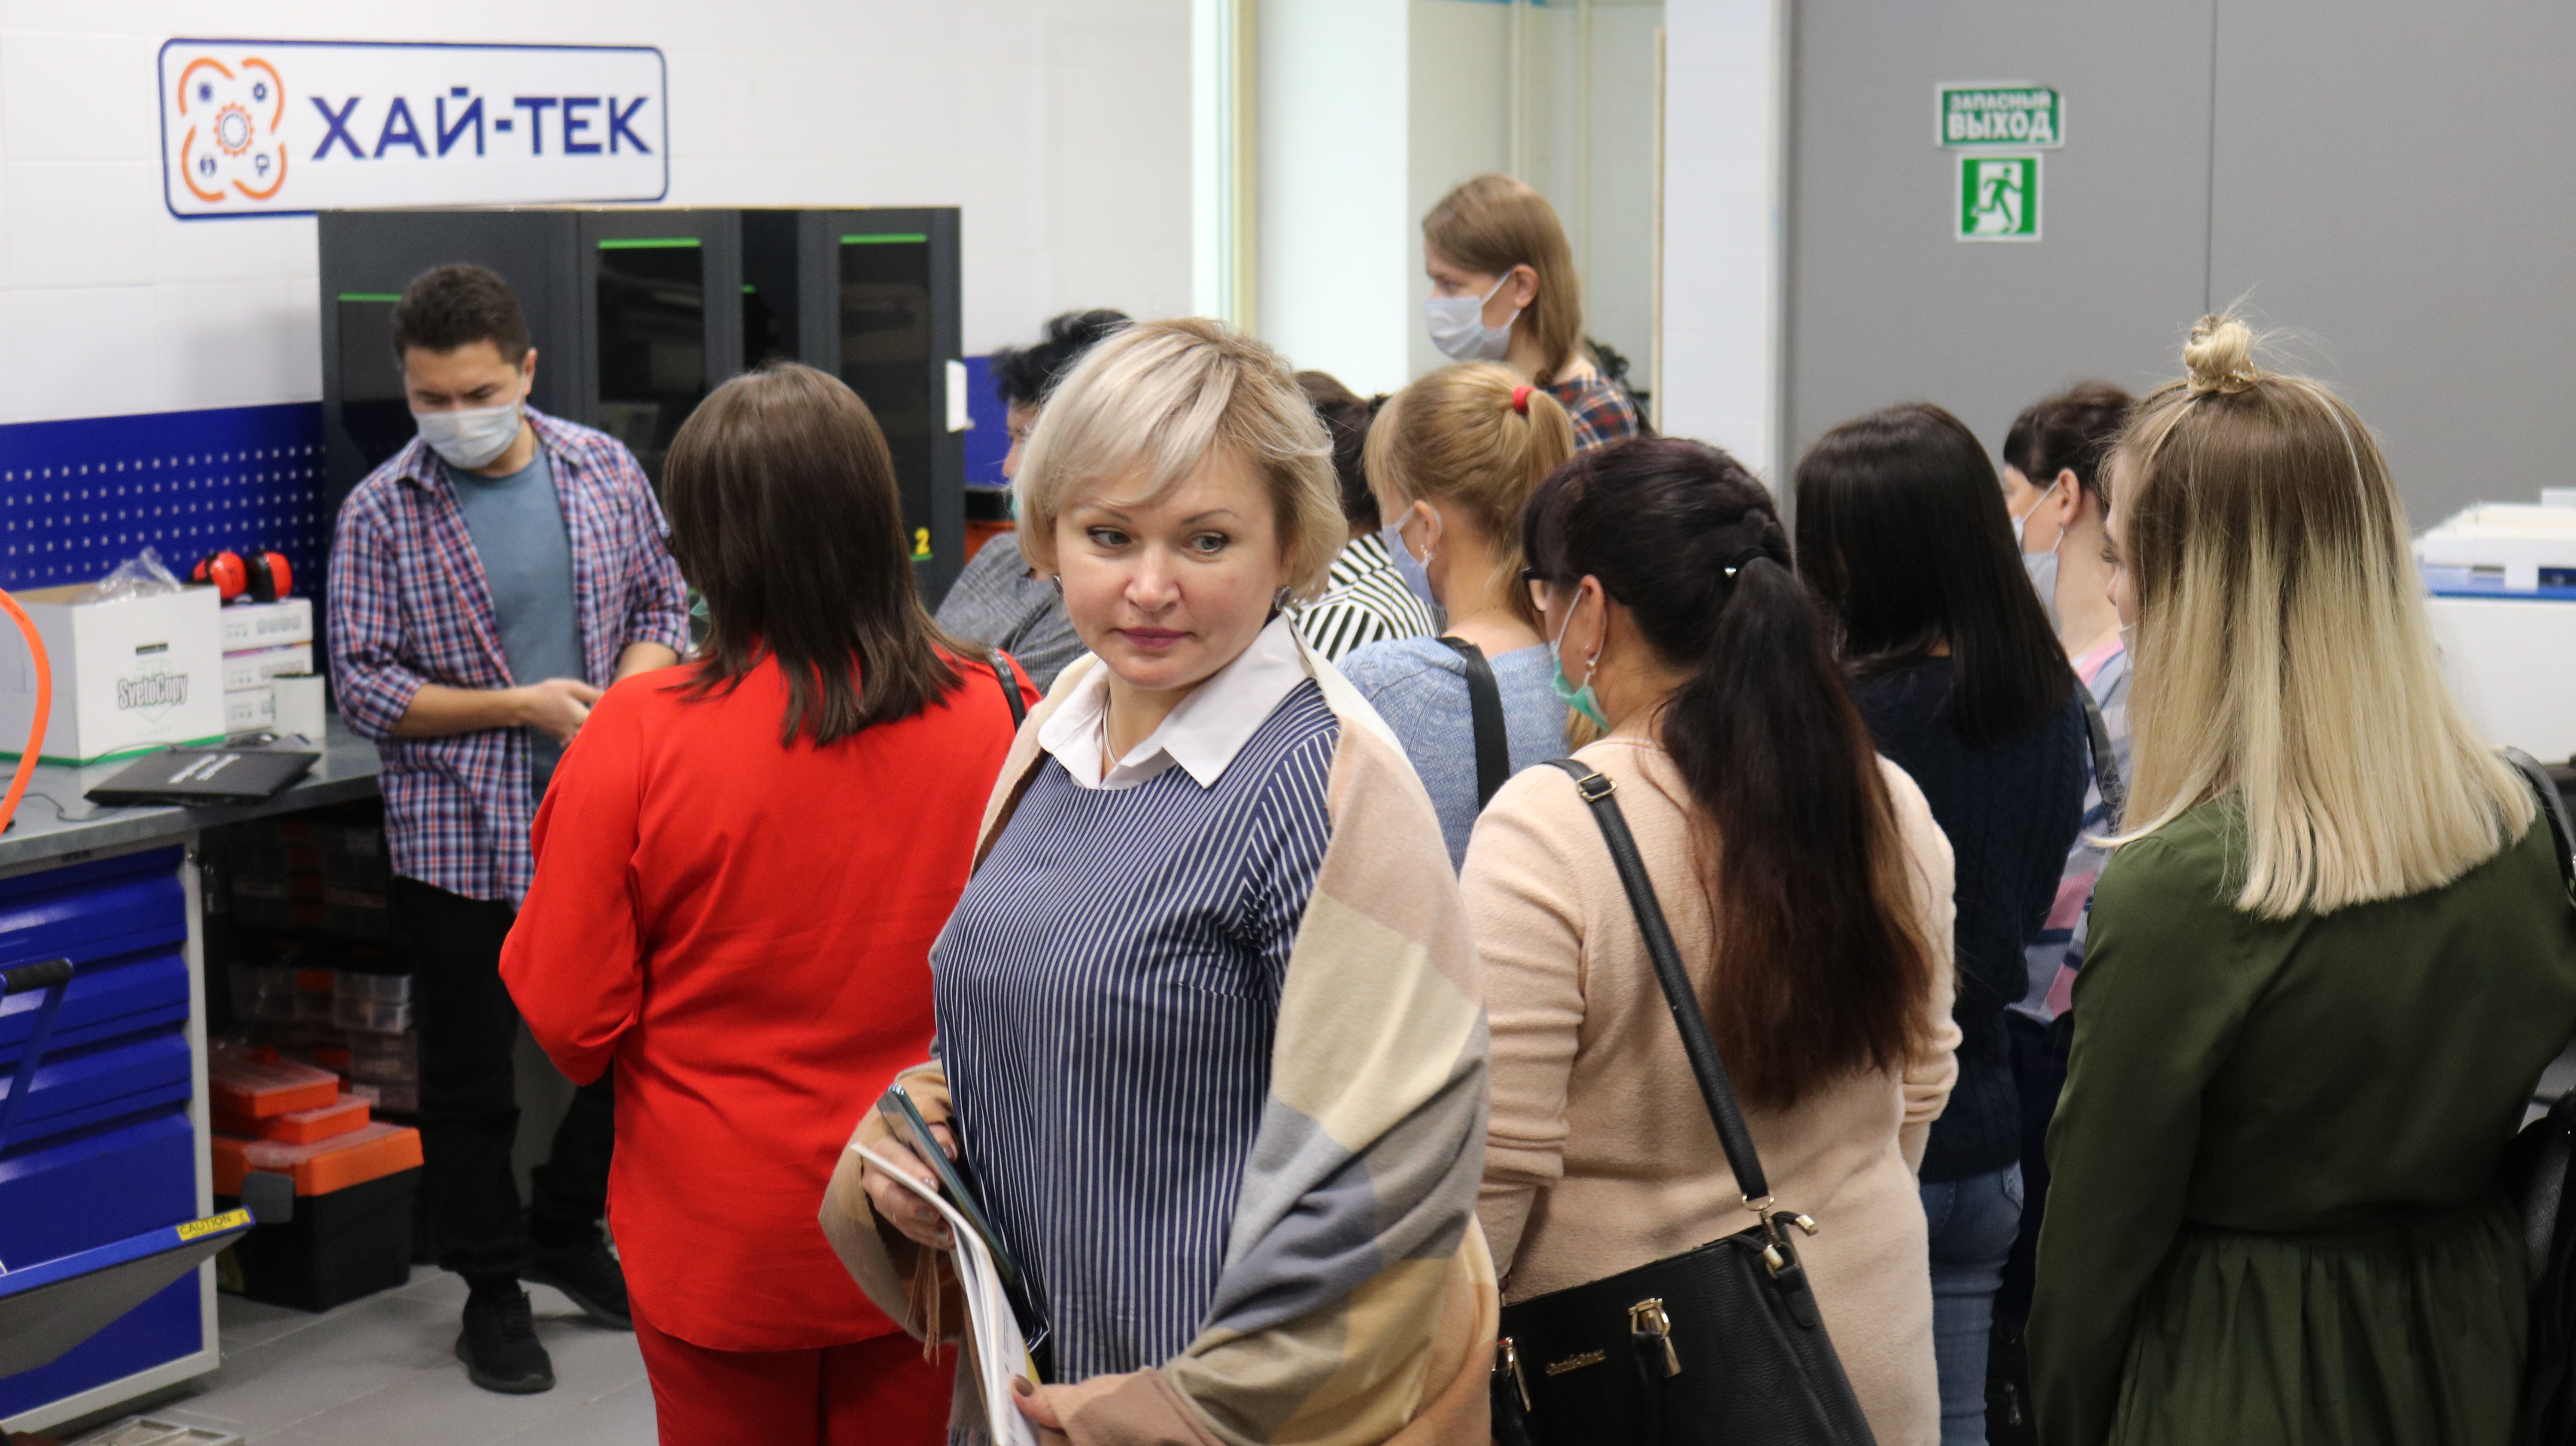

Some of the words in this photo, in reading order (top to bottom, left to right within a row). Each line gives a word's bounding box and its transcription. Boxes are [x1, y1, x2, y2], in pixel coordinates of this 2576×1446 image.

[1950, 90, 2051, 111] ЗАПАСНЫЙ
[310, 86, 653, 161] ХАЙ-ТЕК
[1948, 111, 2053, 143] ВЫХОД
[915, 527, 930, 555] 2
[118, 672, 188, 710] SvetoCopy
[180, 1214, 231, 1235] CAUTION
